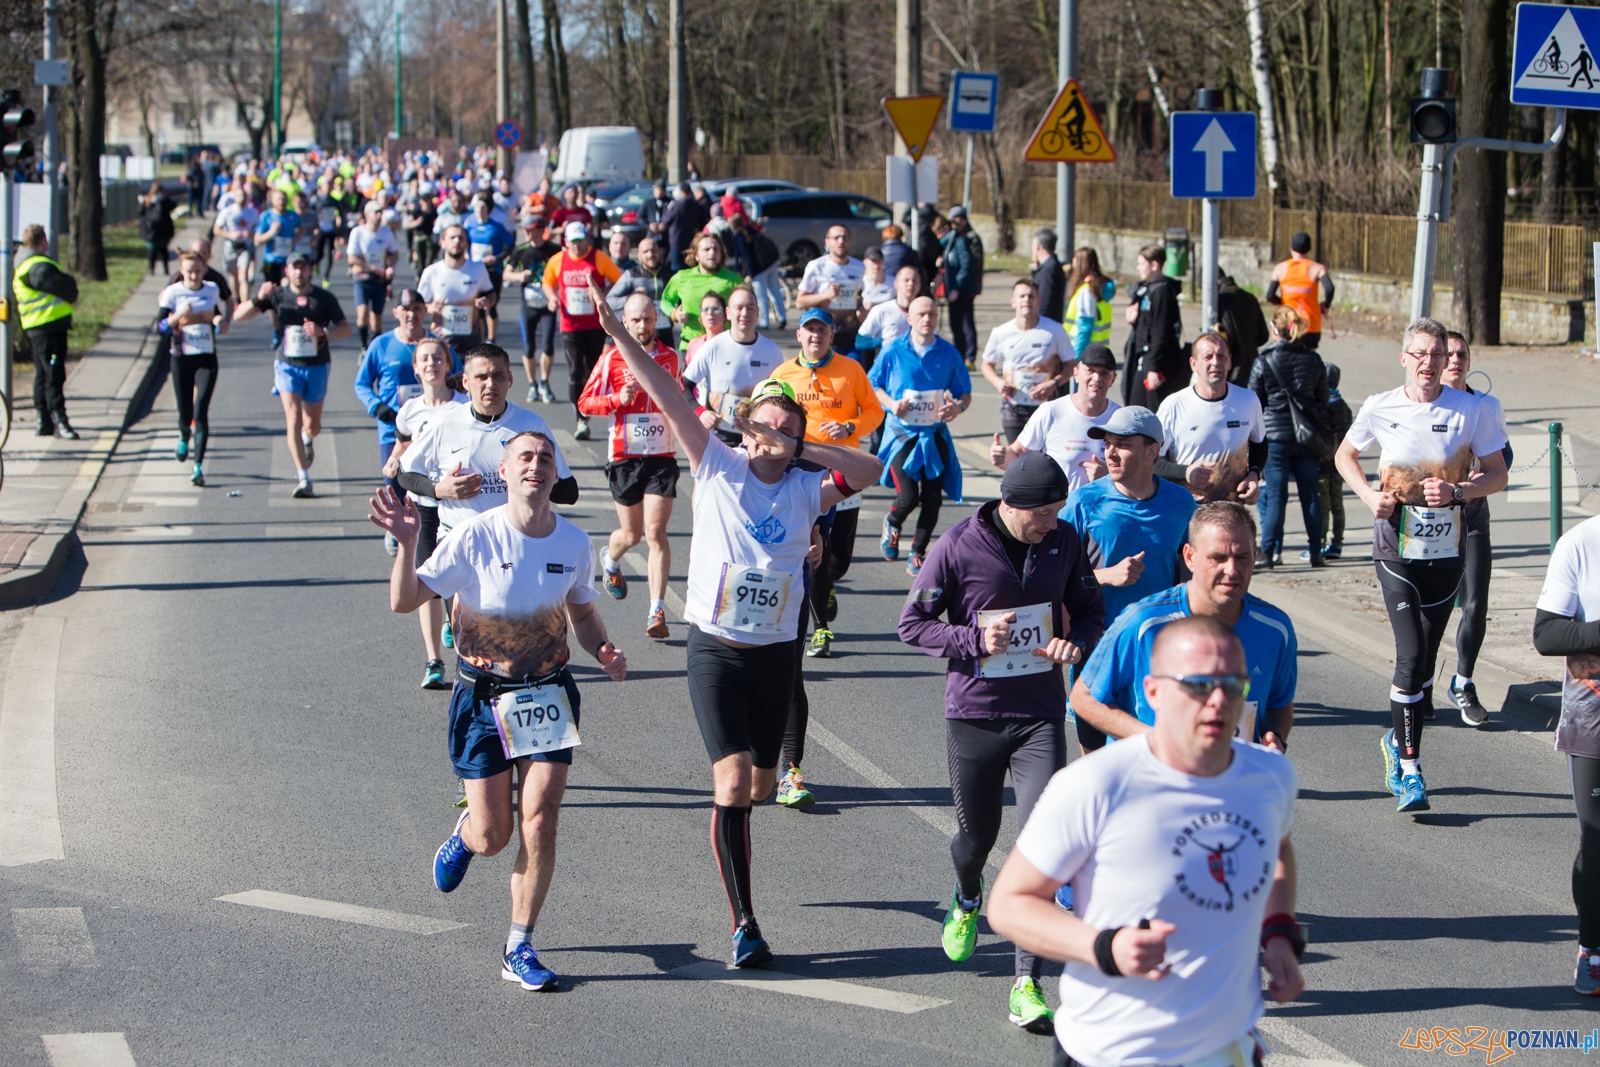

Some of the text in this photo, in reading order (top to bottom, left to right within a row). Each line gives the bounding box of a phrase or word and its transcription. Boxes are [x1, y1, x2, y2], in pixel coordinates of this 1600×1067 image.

[797, 393, 820, 402] RUN
[907, 401, 935, 412] 5470
[634, 425, 665, 437] 5699
[1414, 522, 1453, 538] 2297
[736, 585, 779, 608] 9156
[512, 704, 560, 728] 1790
